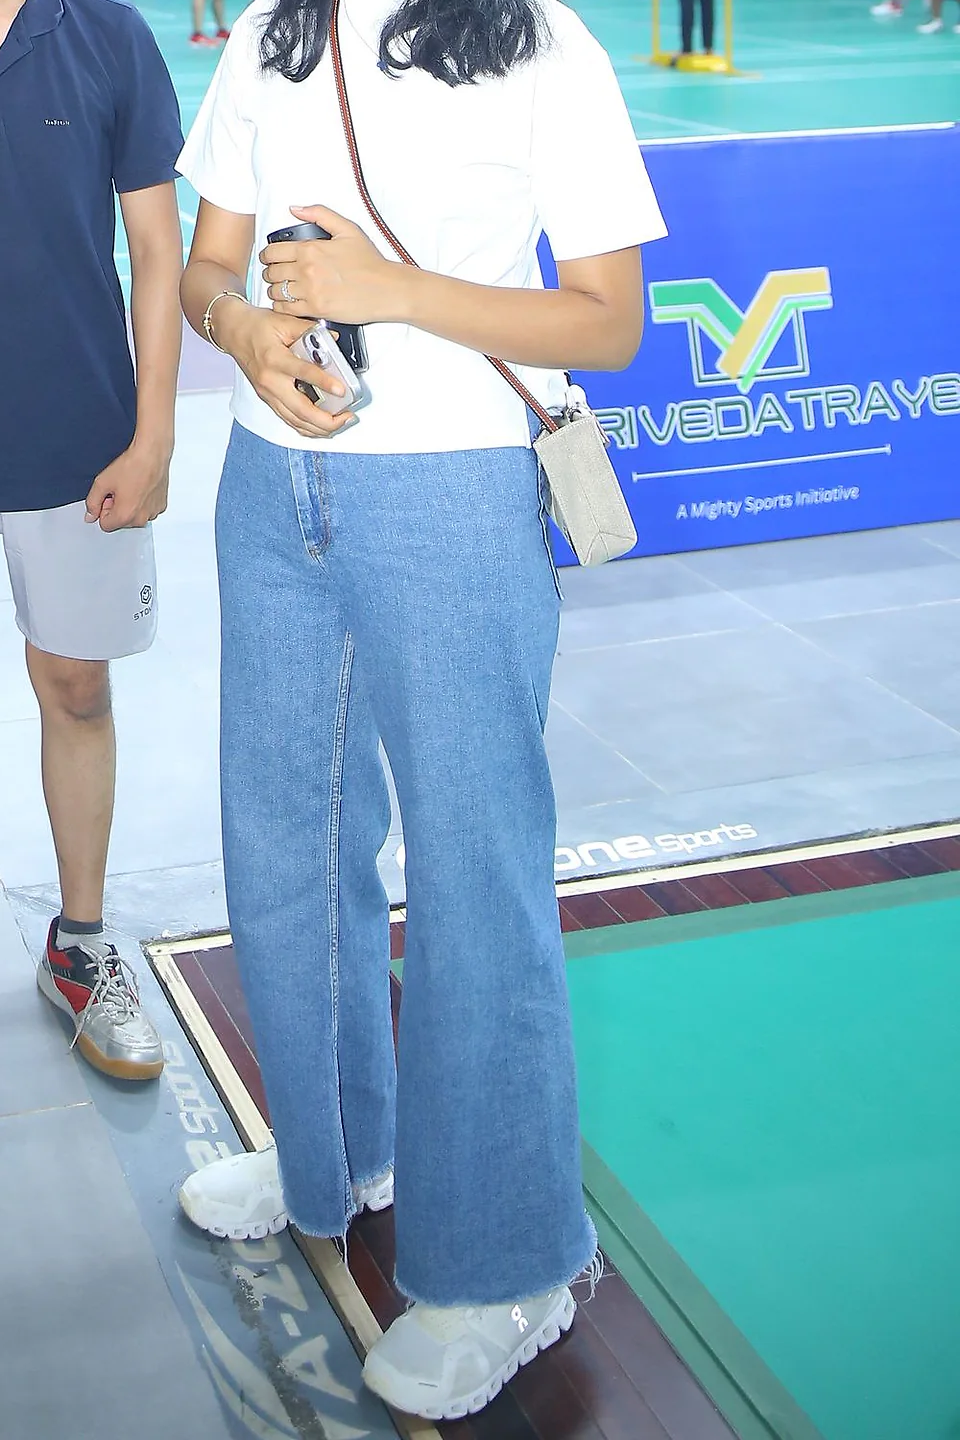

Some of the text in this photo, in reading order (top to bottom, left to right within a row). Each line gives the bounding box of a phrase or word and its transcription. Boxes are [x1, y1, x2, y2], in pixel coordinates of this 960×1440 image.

[676, 485, 860, 521] A Mighty Sports Initiative
[654, 822, 758, 854] Sports
